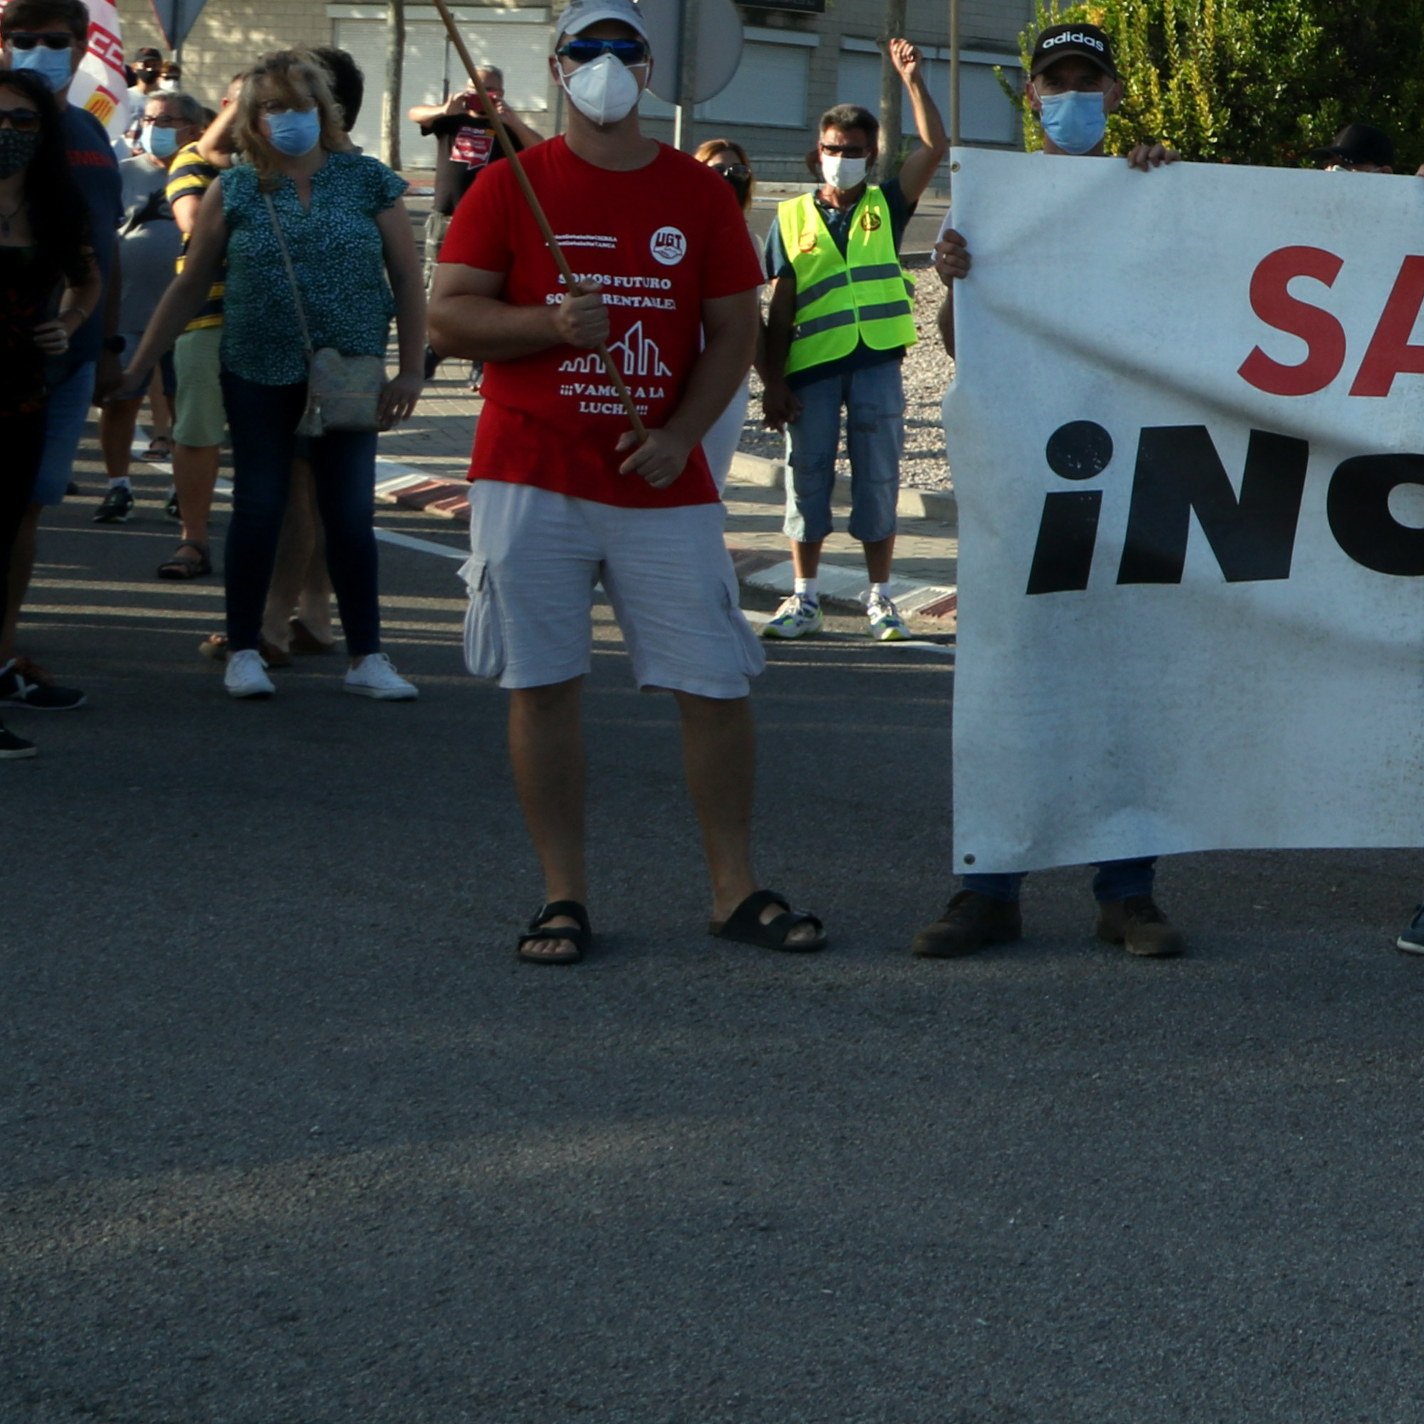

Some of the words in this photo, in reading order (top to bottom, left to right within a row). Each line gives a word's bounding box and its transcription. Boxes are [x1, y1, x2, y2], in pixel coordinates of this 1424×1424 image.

[1042, 31, 1104, 52] adidas
[655, 232, 682, 249] UGT
[613, 276, 672, 290] FUTURO
[635, 387, 646, 398] A
[649, 387, 665, 399] LA
[579, 401, 648, 415] LUCH!!!
